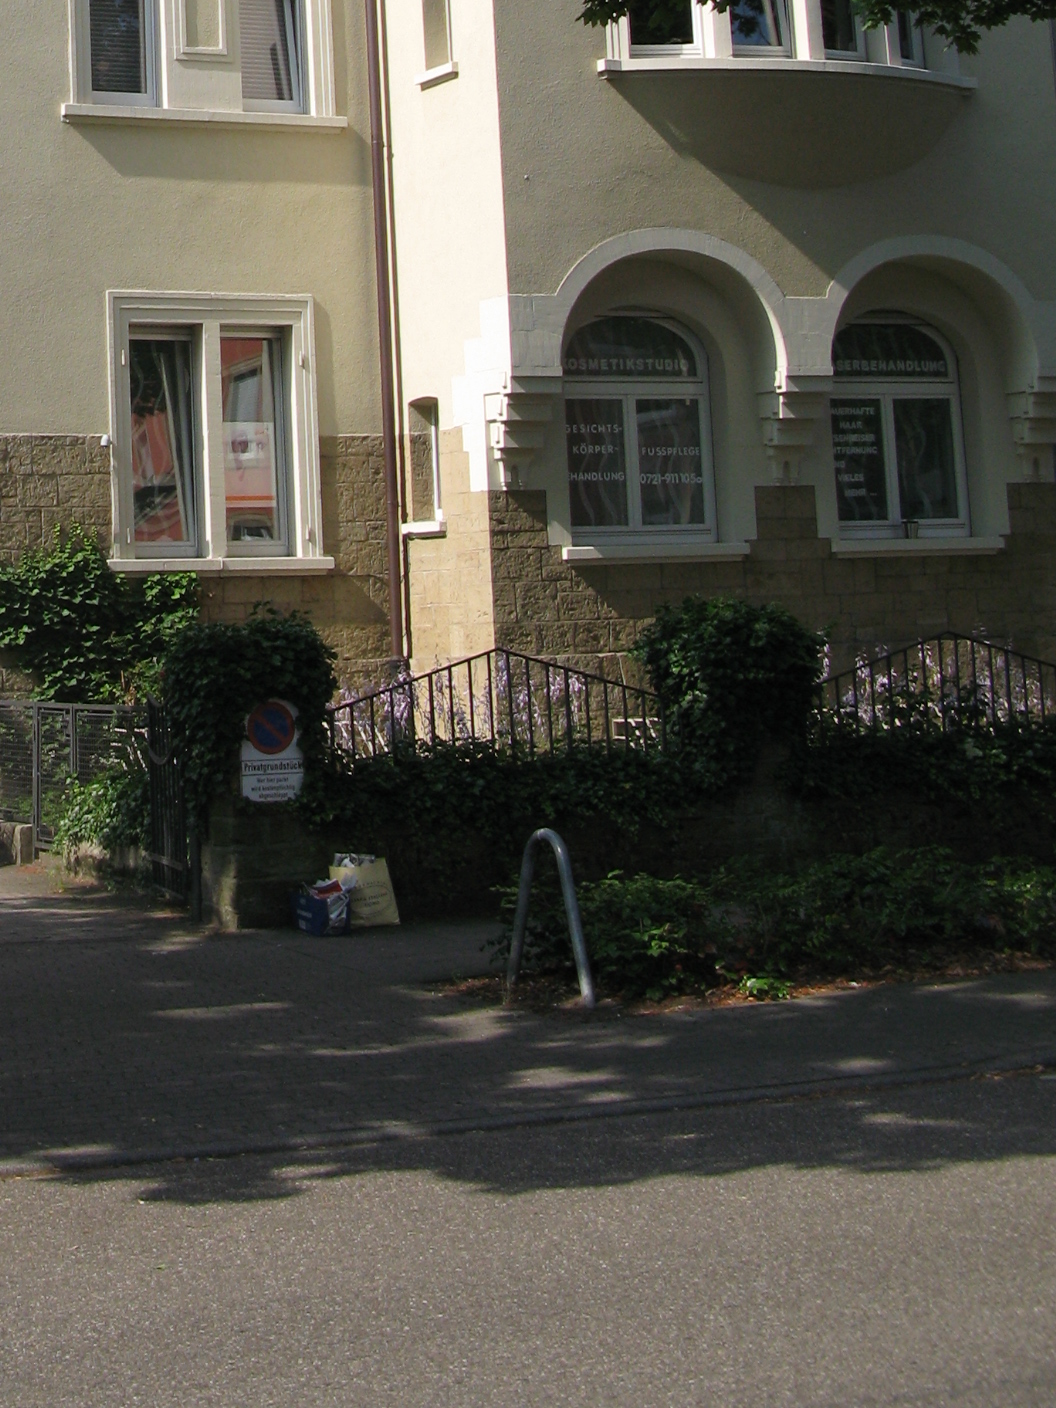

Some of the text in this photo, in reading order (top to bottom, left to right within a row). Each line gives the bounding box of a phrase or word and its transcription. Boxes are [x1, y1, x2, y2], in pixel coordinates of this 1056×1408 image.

[835, 359, 946, 372] SERBEHANDLUNG
[565, 424, 622, 434] GESICHTS-
[840, 421, 863, 429] HAAR
[572, 442, 619, 454] KÖRPER-
[641, 447, 700, 456] FUSSPFLEGE
[244, 760, 301, 773] Privatgrundstück
